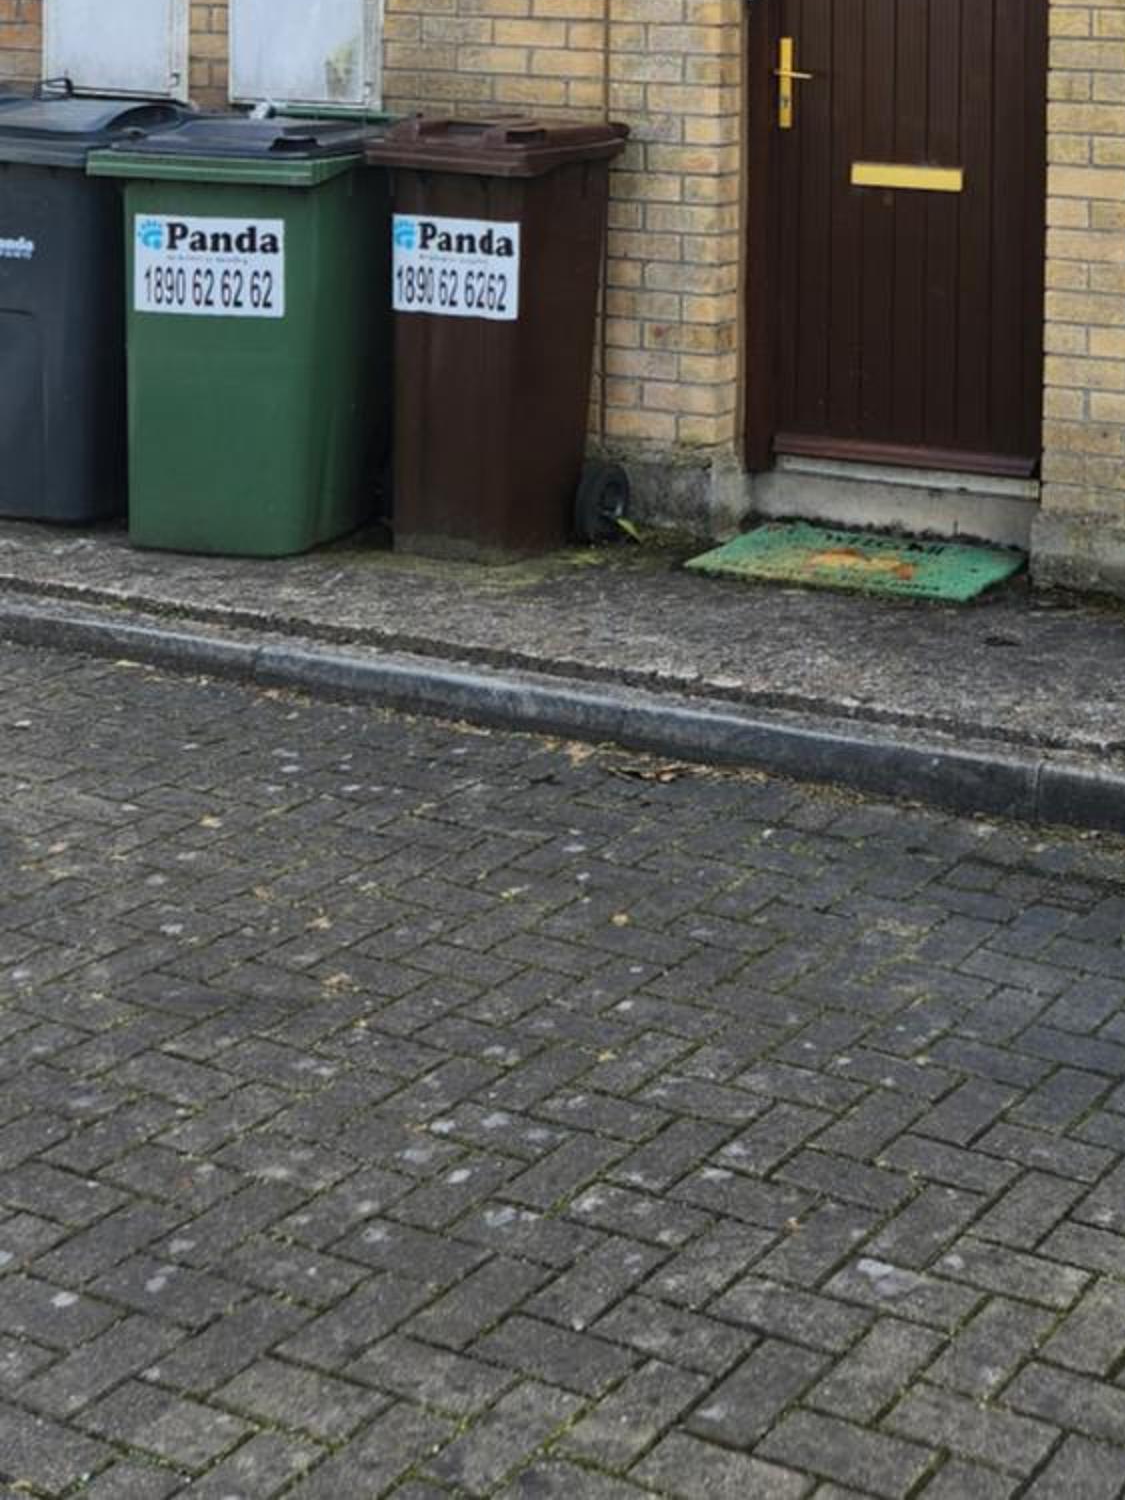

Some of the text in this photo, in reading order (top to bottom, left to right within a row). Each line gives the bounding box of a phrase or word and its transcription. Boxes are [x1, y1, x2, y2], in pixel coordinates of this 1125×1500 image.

[166, 222, 279, 254] Panda
[418, 222, 514, 258] Panda
[145, 265, 272, 308] 1890 62 62 62
[397, 265, 434, 304] 1890
[439, 268, 458, 307] 62
